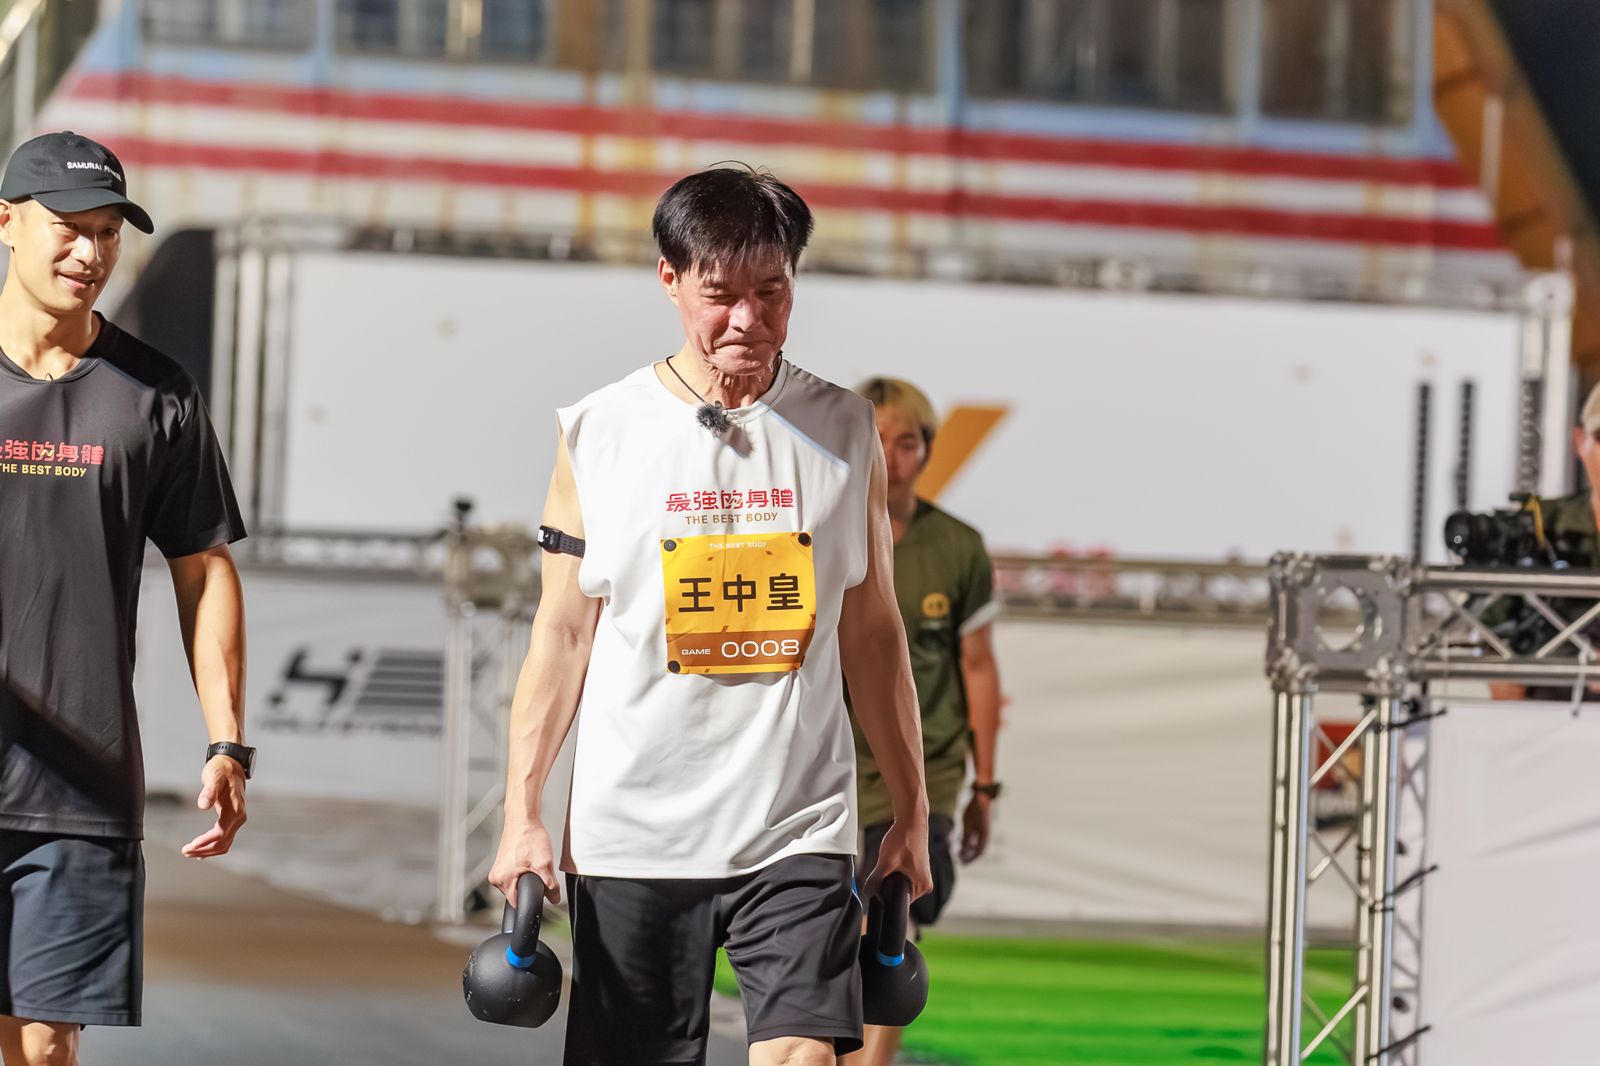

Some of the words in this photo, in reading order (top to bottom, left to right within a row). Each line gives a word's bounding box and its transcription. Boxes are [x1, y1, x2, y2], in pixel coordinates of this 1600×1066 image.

[67, 161, 102, 170] SAMURAI
[0, 440, 104, 464] 強的身體
[21, 464, 52, 475] BEST
[54, 466, 87, 478] BODY
[666, 489, 794, 512] 最強的身體
[685, 515, 708, 525] THE
[712, 513, 741, 524] BEST
[745, 512, 778, 523] BODY
[678, 573, 803, 612] 王中皇
[681, 648, 711, 656] GAME
[721, 639, 800, 658] 0008
